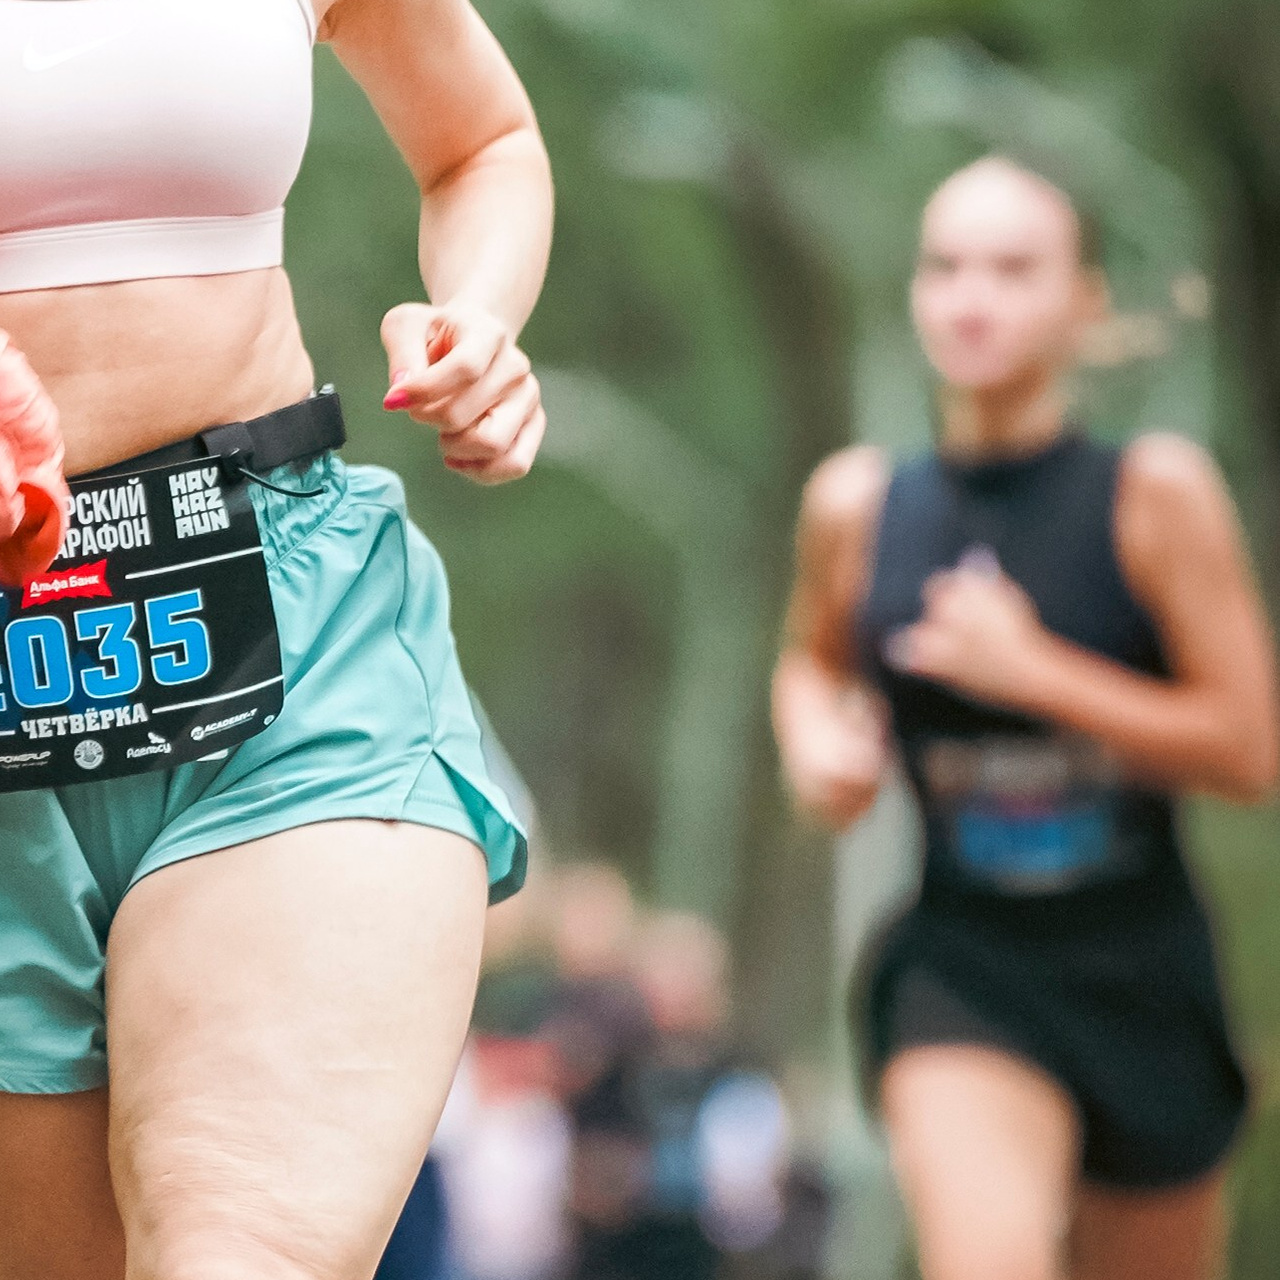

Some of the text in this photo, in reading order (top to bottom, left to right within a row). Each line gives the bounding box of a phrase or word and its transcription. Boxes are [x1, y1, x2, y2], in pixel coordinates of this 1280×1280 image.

[175, 508, 231, 539] RUN
[68, 575, 99, 588] Банк
[20, 702, 149, 739] ЧЕТВЁРКА
